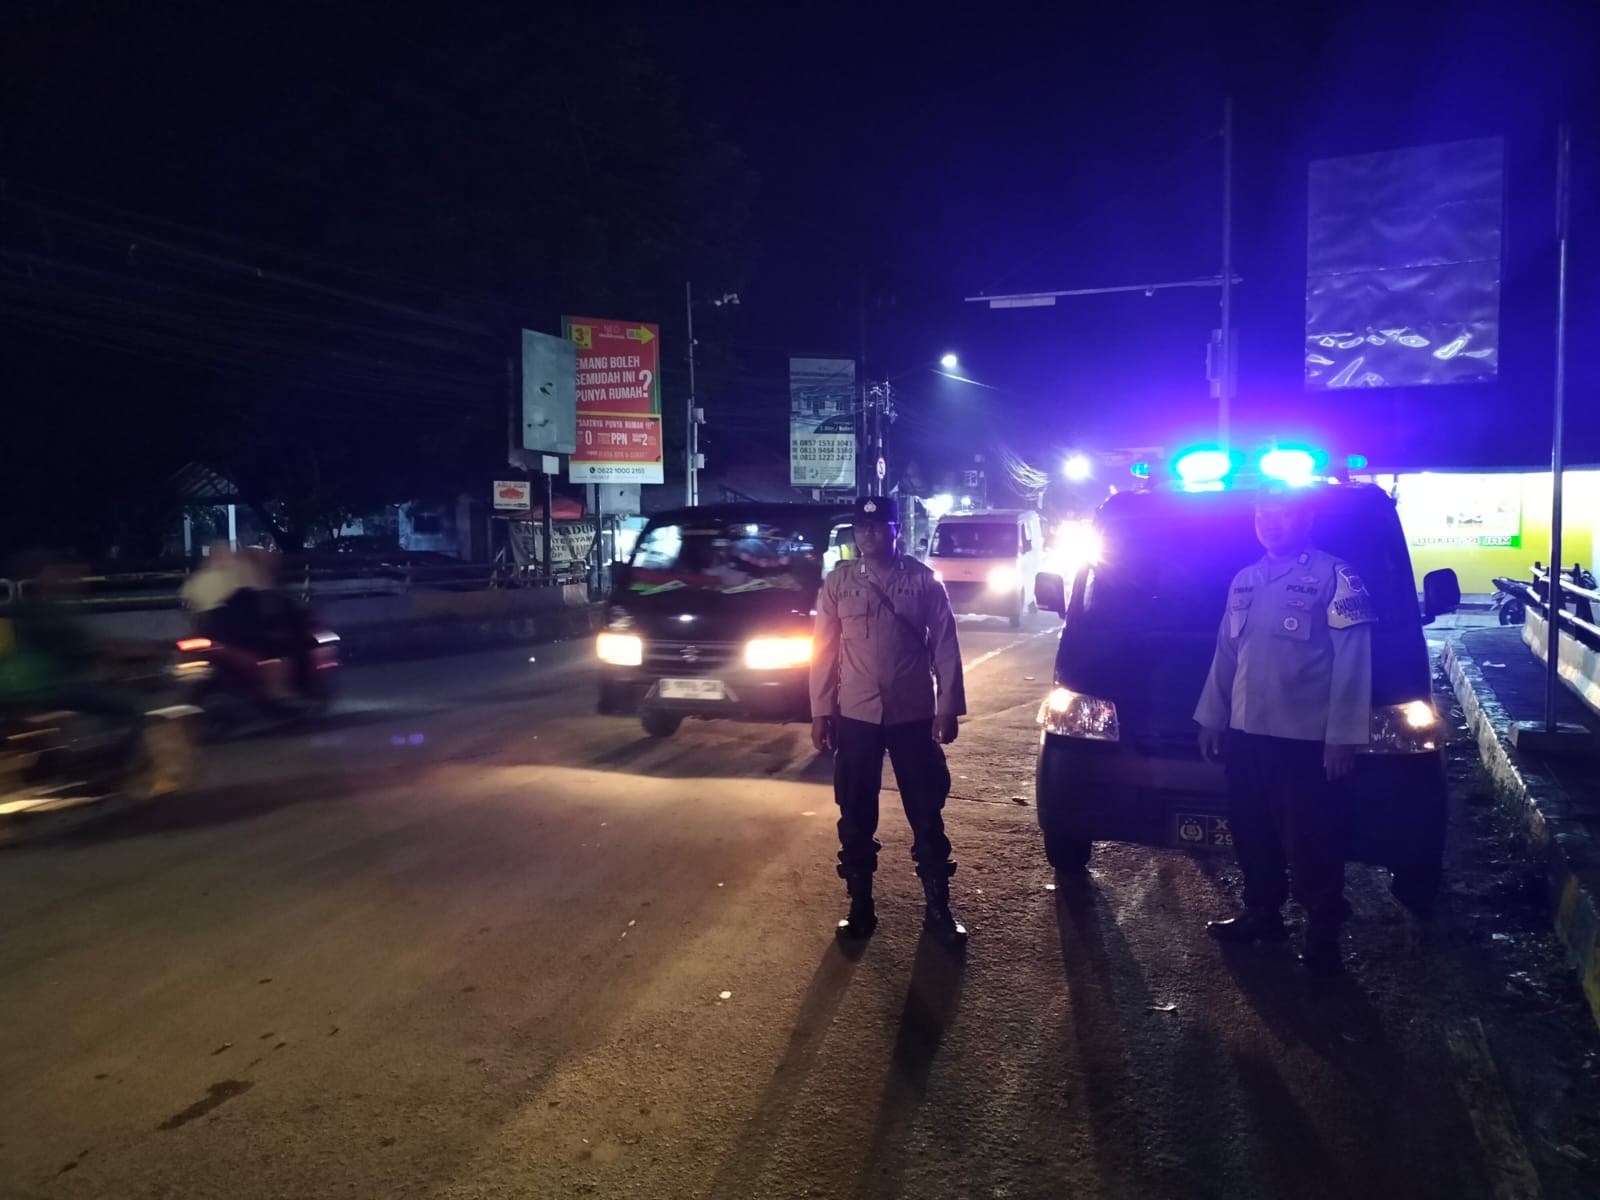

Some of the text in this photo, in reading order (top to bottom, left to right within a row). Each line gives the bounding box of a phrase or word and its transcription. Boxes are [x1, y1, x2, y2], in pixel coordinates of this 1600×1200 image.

[610, 356, 640, 368] BOLEH
[575, 370, 636, 385] SEMUDAH INI
[575, 389, 606, 402] PUNYA
[609, 386, 642, 400] RUMAH
[611, 432, 628, 445] PPN
[552, 524, 597, 536] MADUR
[1286, 584, 1318, 595] POLRI
